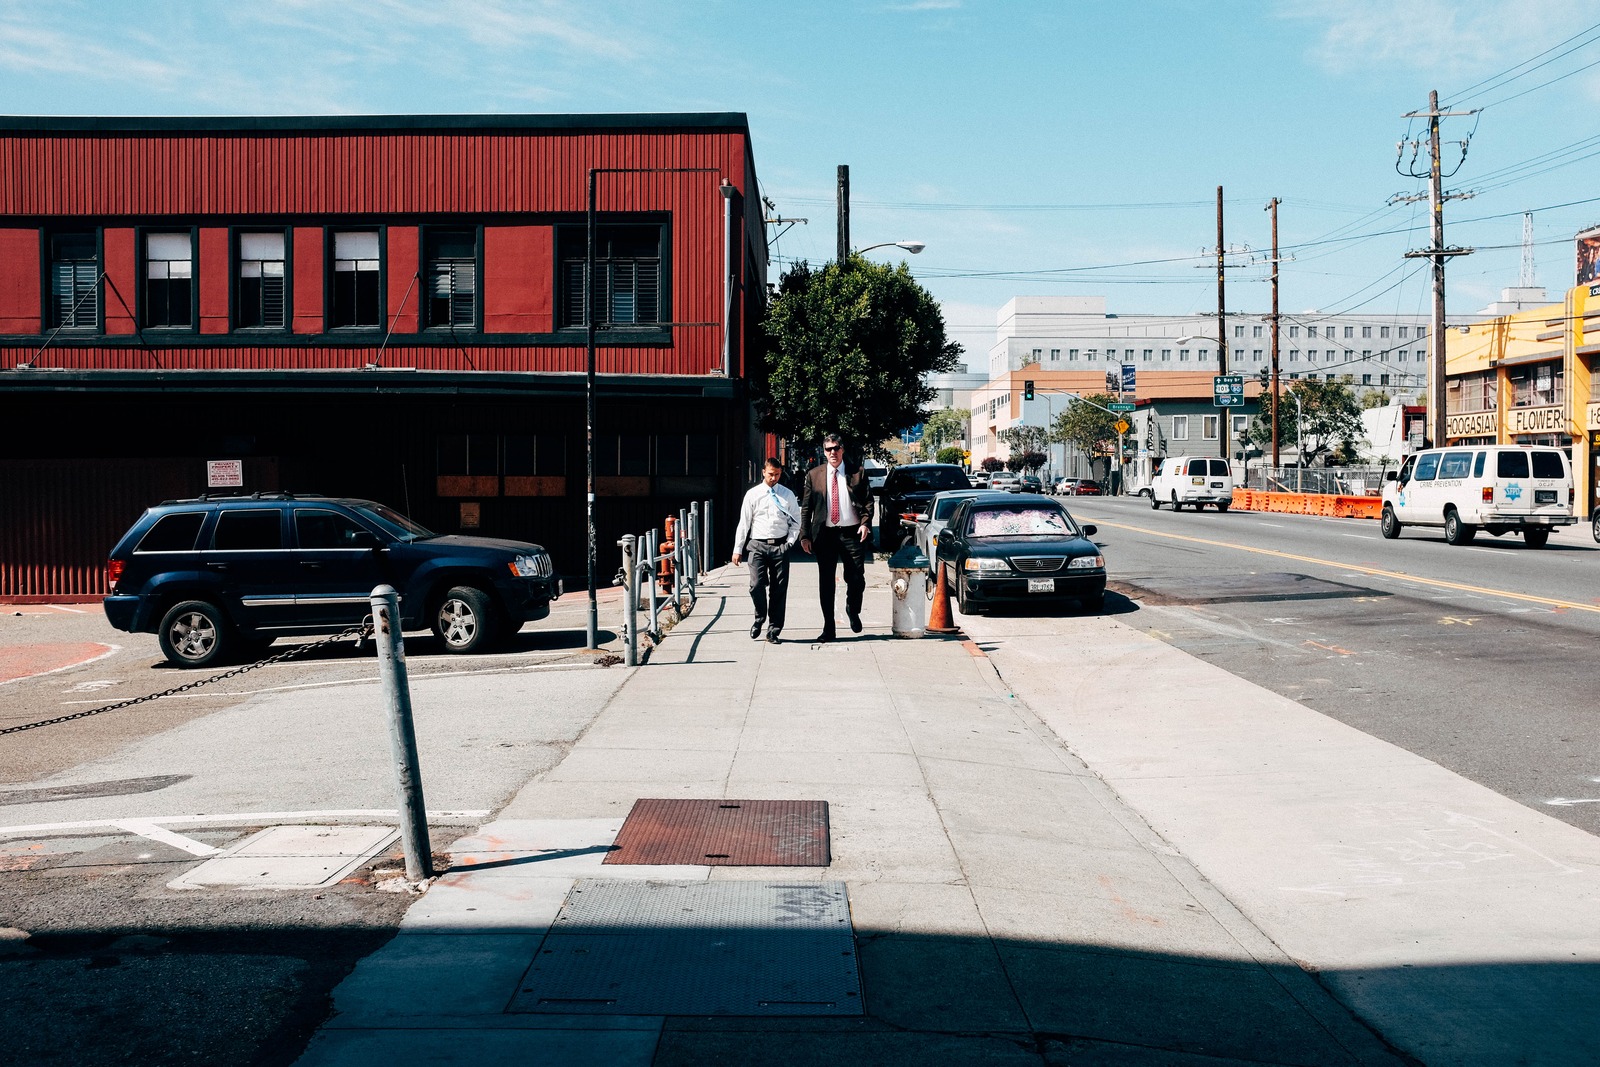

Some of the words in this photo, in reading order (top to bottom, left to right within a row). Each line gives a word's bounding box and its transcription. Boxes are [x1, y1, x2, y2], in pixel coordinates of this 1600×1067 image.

[1447, 414, 1497, 435] HOOGASIAN
[1434, 480, 1463, 488] PREVENTION
[1506, 487, 1521, 495] SFPD
